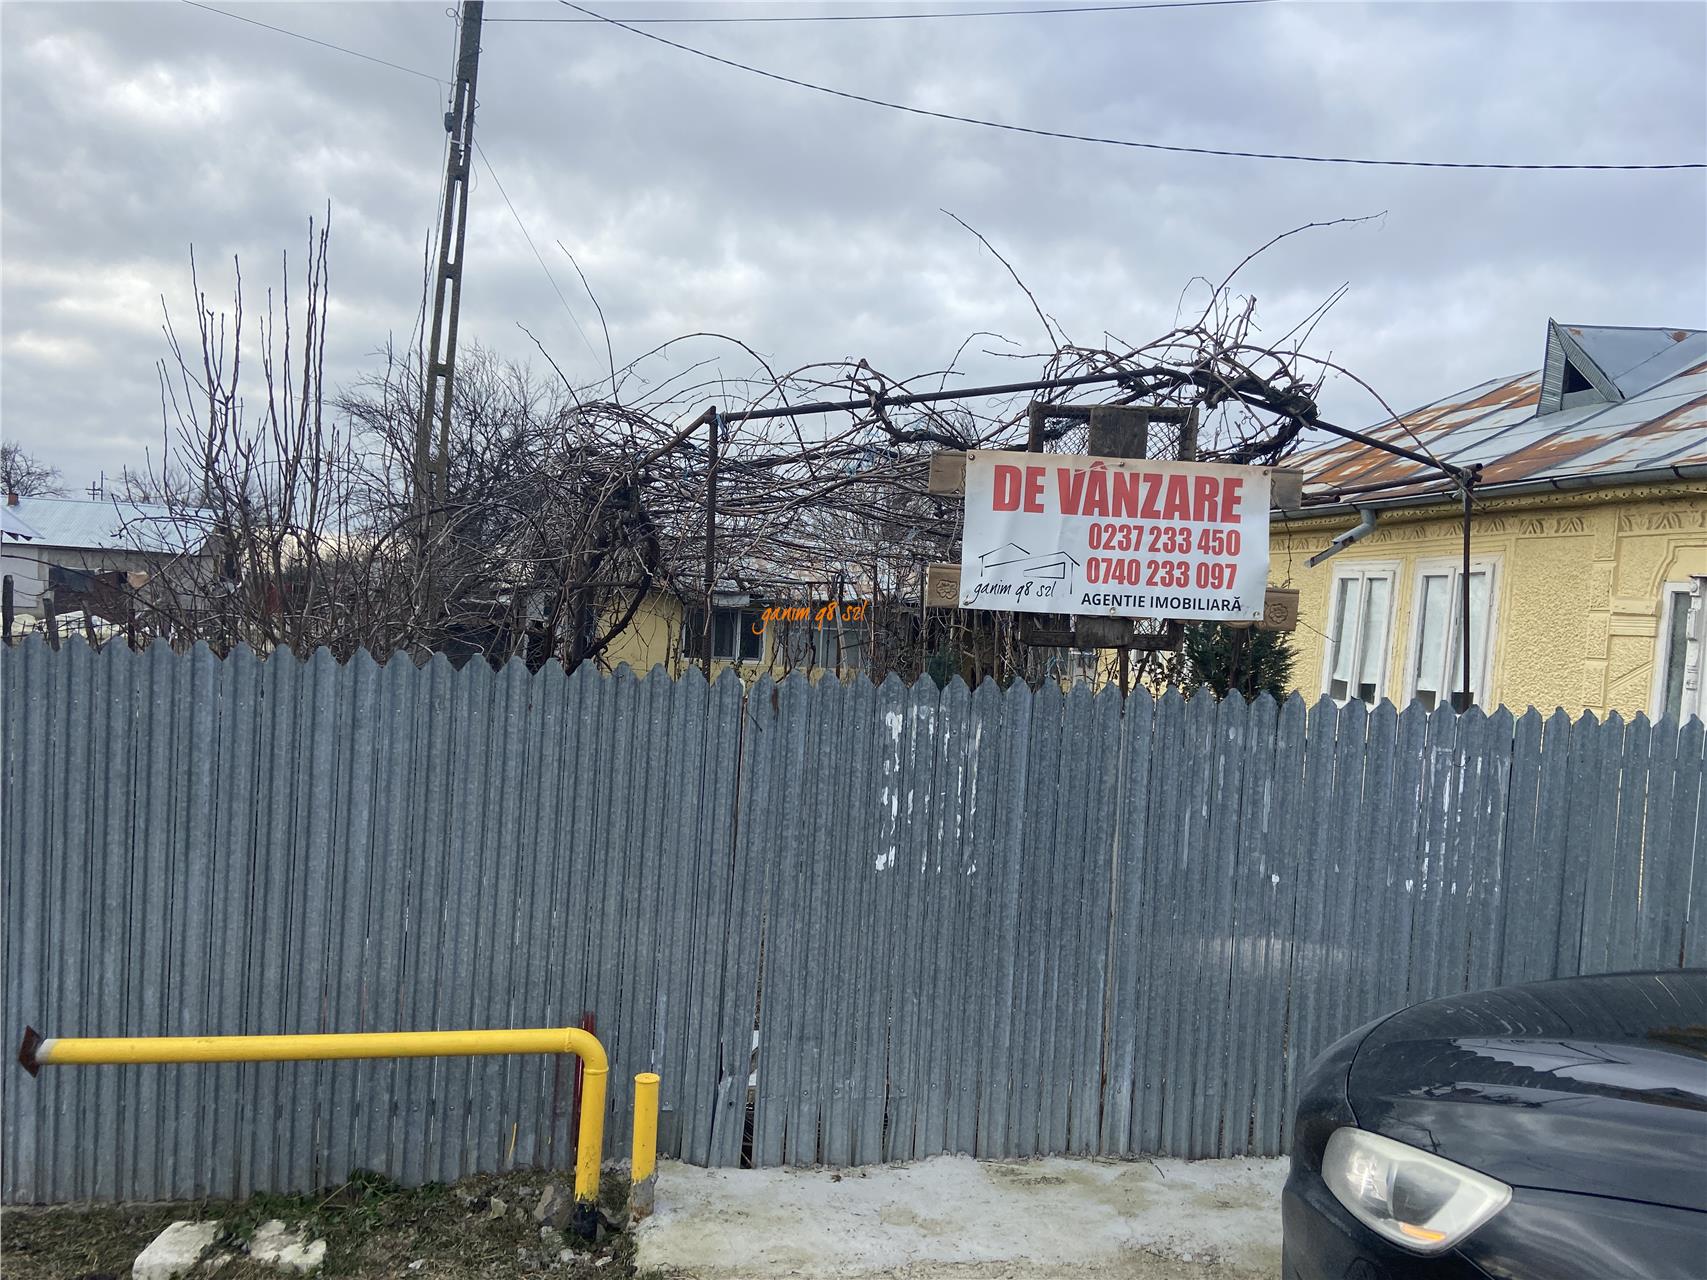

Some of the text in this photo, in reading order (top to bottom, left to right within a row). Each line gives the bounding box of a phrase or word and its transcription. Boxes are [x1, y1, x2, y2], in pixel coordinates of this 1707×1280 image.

[992, 460, 1244, 524] DE VÂNZARE
[1088, 522, 1241, 557] 0237 233 450
[1086, 556, 1237, 590] 0740 233 097
[963, 579, 1012, 606] ganim
[1081, 592, 1242, 612] AGENTIE IMOBILIARĂ
